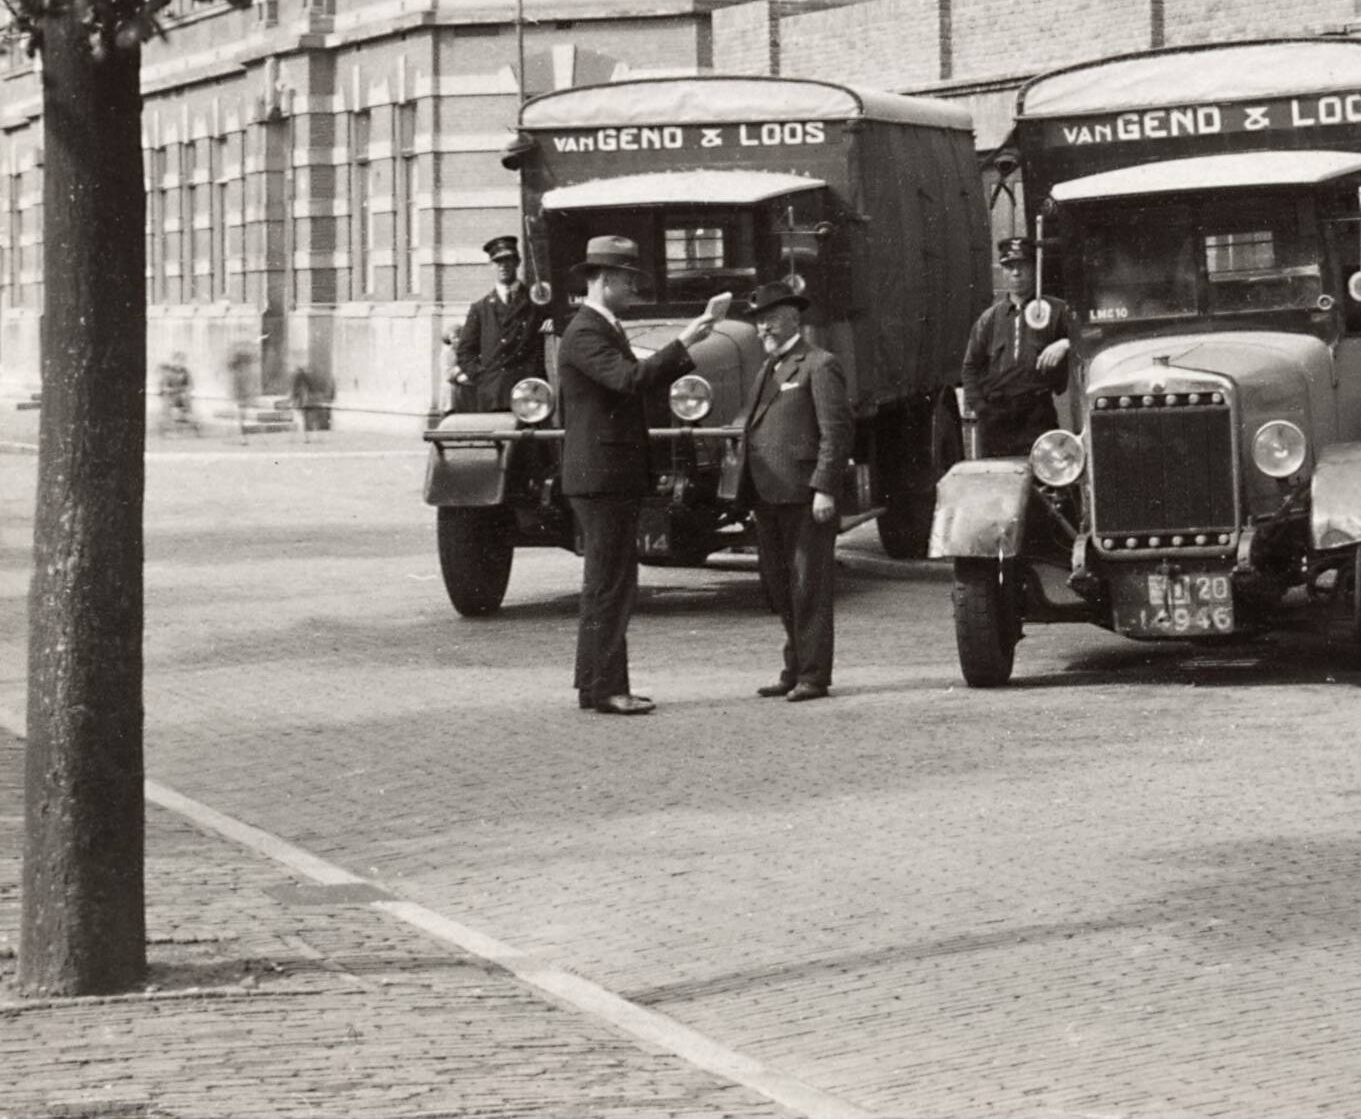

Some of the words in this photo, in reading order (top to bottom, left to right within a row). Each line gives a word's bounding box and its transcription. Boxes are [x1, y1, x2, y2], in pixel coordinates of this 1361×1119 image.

[597, 127, 683, 151] GEND
[701, 128, 722, 148] &
[740, 122, 825, 147] LOOS
[1116, 106, 1221, 140] GEND
[1243, 106, 1270, 130] &
